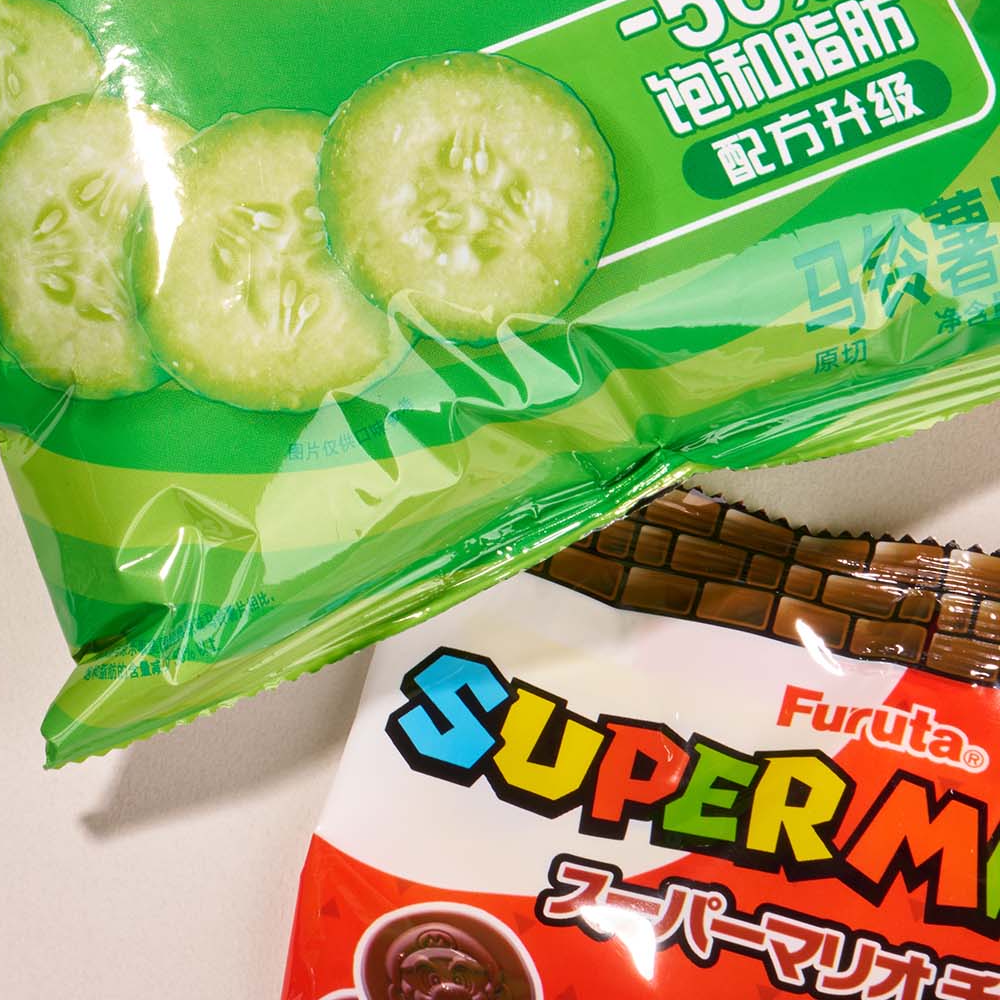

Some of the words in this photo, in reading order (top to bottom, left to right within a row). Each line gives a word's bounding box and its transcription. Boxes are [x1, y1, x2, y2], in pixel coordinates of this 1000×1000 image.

[711, 71, 926, 187] 配方升级
[792, 178, 1000, 335] 马铃薯
[814, 339, 868, 375] 原切
[390, 649, 853, 870] SUPER
[838, 772, 1000, 930] M
